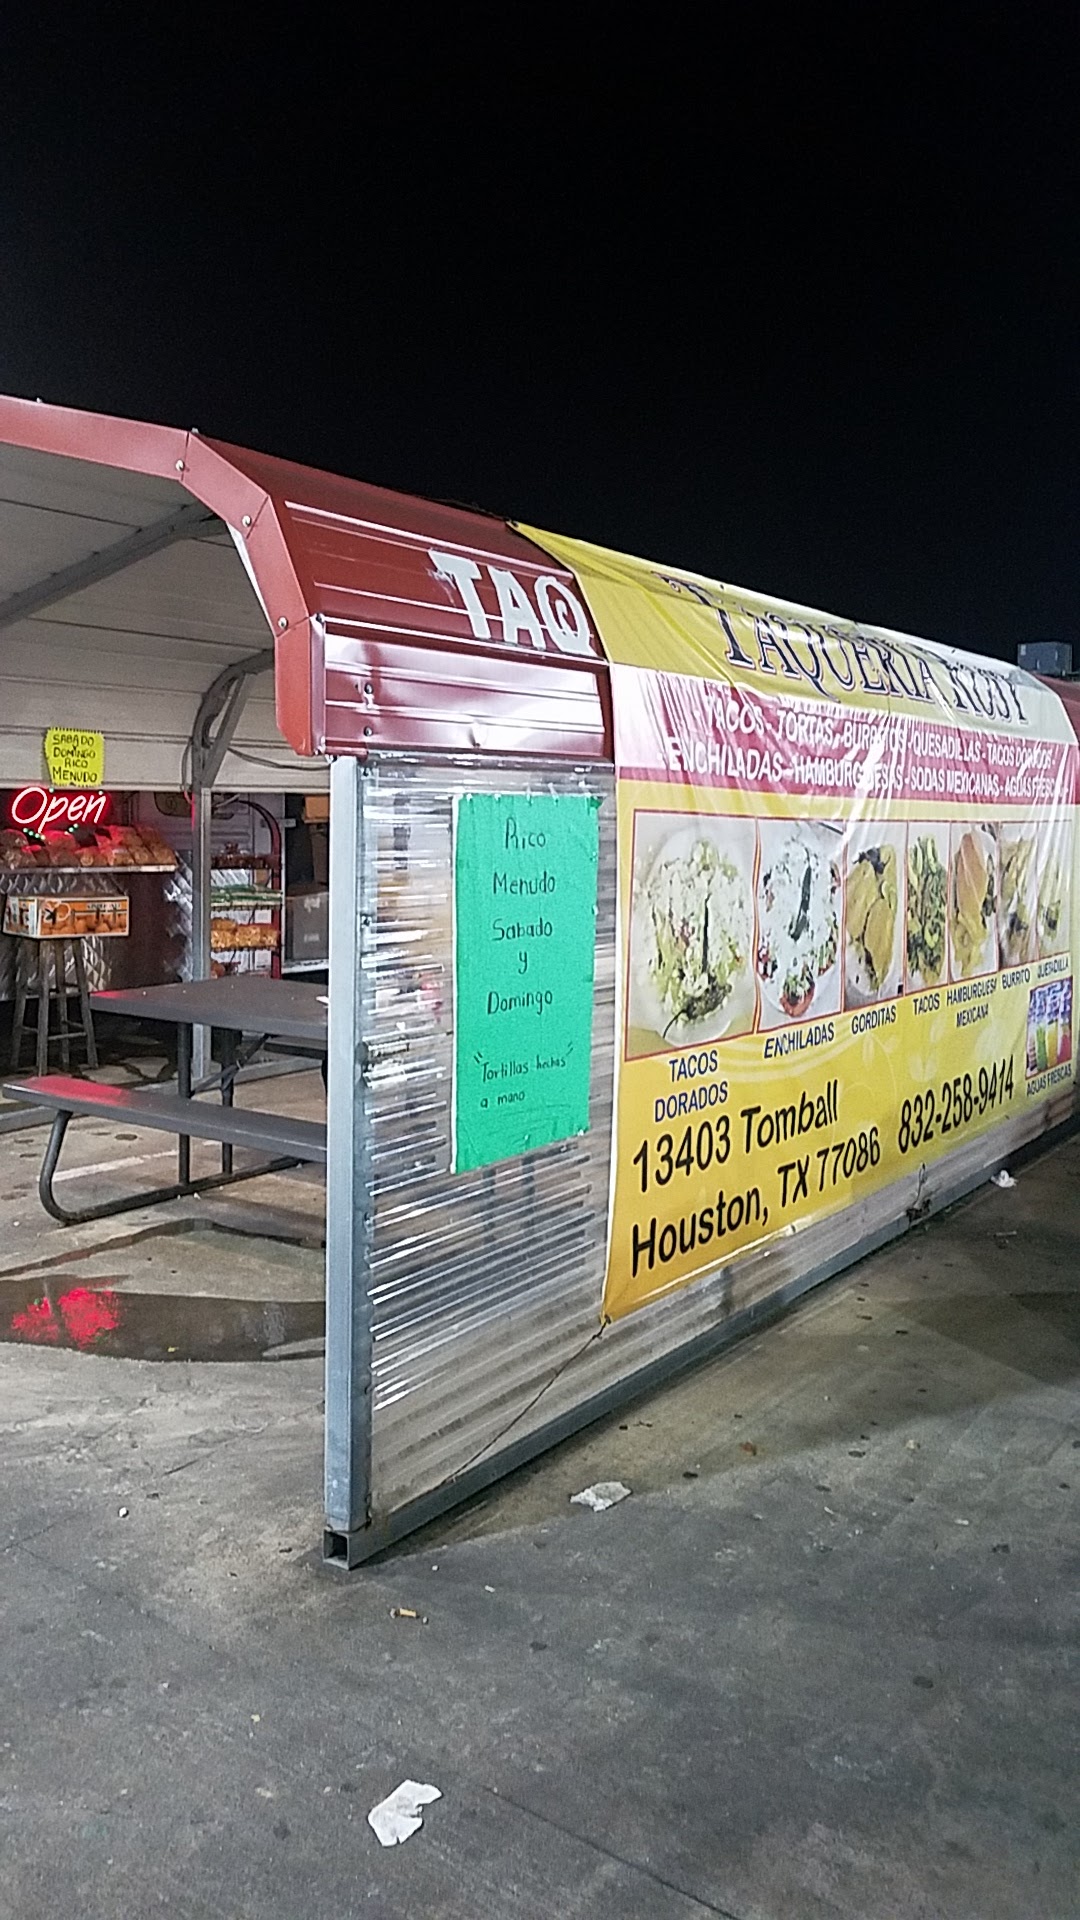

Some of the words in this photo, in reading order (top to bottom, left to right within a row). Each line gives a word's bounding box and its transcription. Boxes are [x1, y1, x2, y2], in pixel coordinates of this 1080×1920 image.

[427, 548, 598, 657] TAQ
[651, 571, 951, 708] TAQUERIA
[52, 734, 95, 746] SABADO
[707, 692, 765, 736] TACOS
[913, 731, 981, 763] QUESADILLAS
[987, 741, 1014, 766] TACOS
[53, 747, 96, 758] DOMINGO
[64, 758, 89, 768] RICO
[666, 736, 783, 782] ENCHILADAS
[911, 768, 945, 791] SODAS
[948, 769, 1000, 796] MEXICANAS
[1004, 775, 1031, 797] AGUAS
[1032, 776, 1066, 798] FRESC
[52, 767, 98, 783] MENUDO
[11, 786, 107, 833] Open
[505, 816, 546, 849] Rico
[493, 870, 556, 895] Menudo
[492, 917, 553, 941] Sabado
[518, 951, 528, 975] y
[946, 978, 998, 1007] HAMBURGUESA
[1002, 968, 1031, 989] BURRITO
[487, 990, 553, 1016] Domingo
[913, 993, 940, 1016] TACOS
[956, 1003, 989, 1028] MEXICANA
[851, 1005, 897, 1034] GORDITAS
[764, 1022, 835, 1059] ENCHILADAS
[669, 1050, 718, 1082] TACOS
[1027, 1077, 1047, 1096] AGUAS
[1047, 1063, 1072, 1088] FRESCAS
[497, 1091, 526, 1105] mano
[654, 1081, 728, 1123] DORADOS
[898, 1054, 1014, 1154] 832-258-9414
[633, 1115, 730, 1193] 13403
[740, 1079, 838, 1154] Tomball
[631, 1187, 769, 1278] Houston,
[777, 1155, 809, 1208] TX
[816, 1126, 880, 1192] 77086
